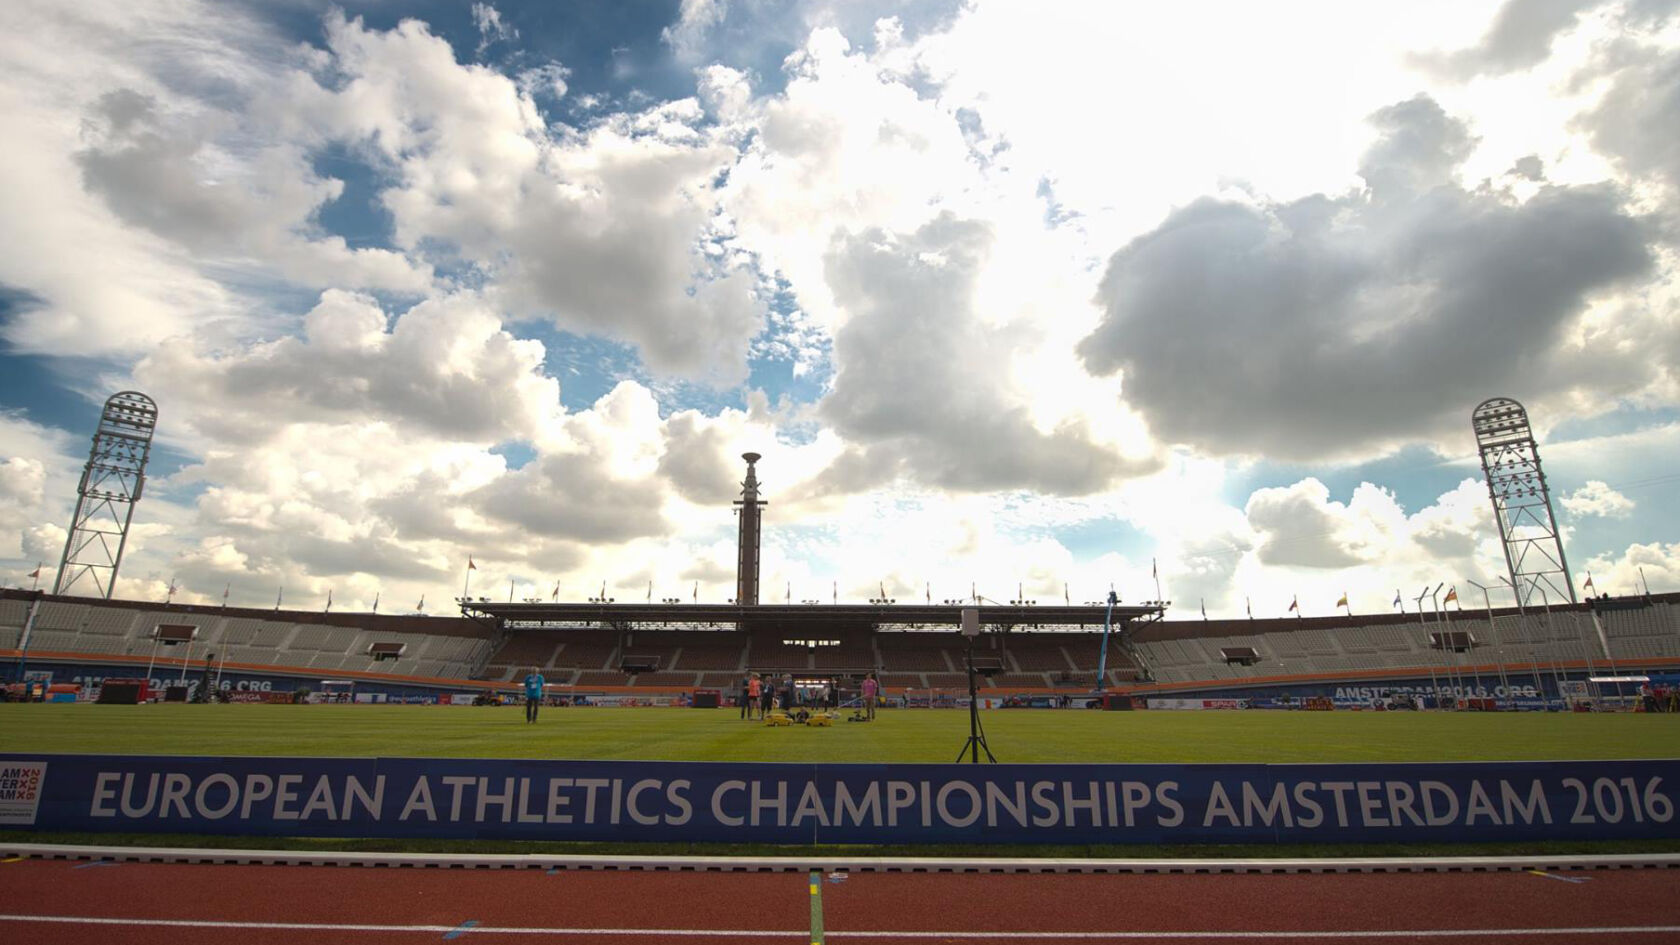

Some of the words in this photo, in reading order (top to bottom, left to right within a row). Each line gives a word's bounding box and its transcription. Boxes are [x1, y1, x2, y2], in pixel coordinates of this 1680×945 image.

[91, 773, 385, 820] EUROPEAN
[400, 776, 692, 825] ATHLETICS
[712, 780, 1184, 827] CHAMPIONSHIPS
[1203, 781, 1552, 827] AMSTERDAM
[1563, 778, 1672, 824] 2016
